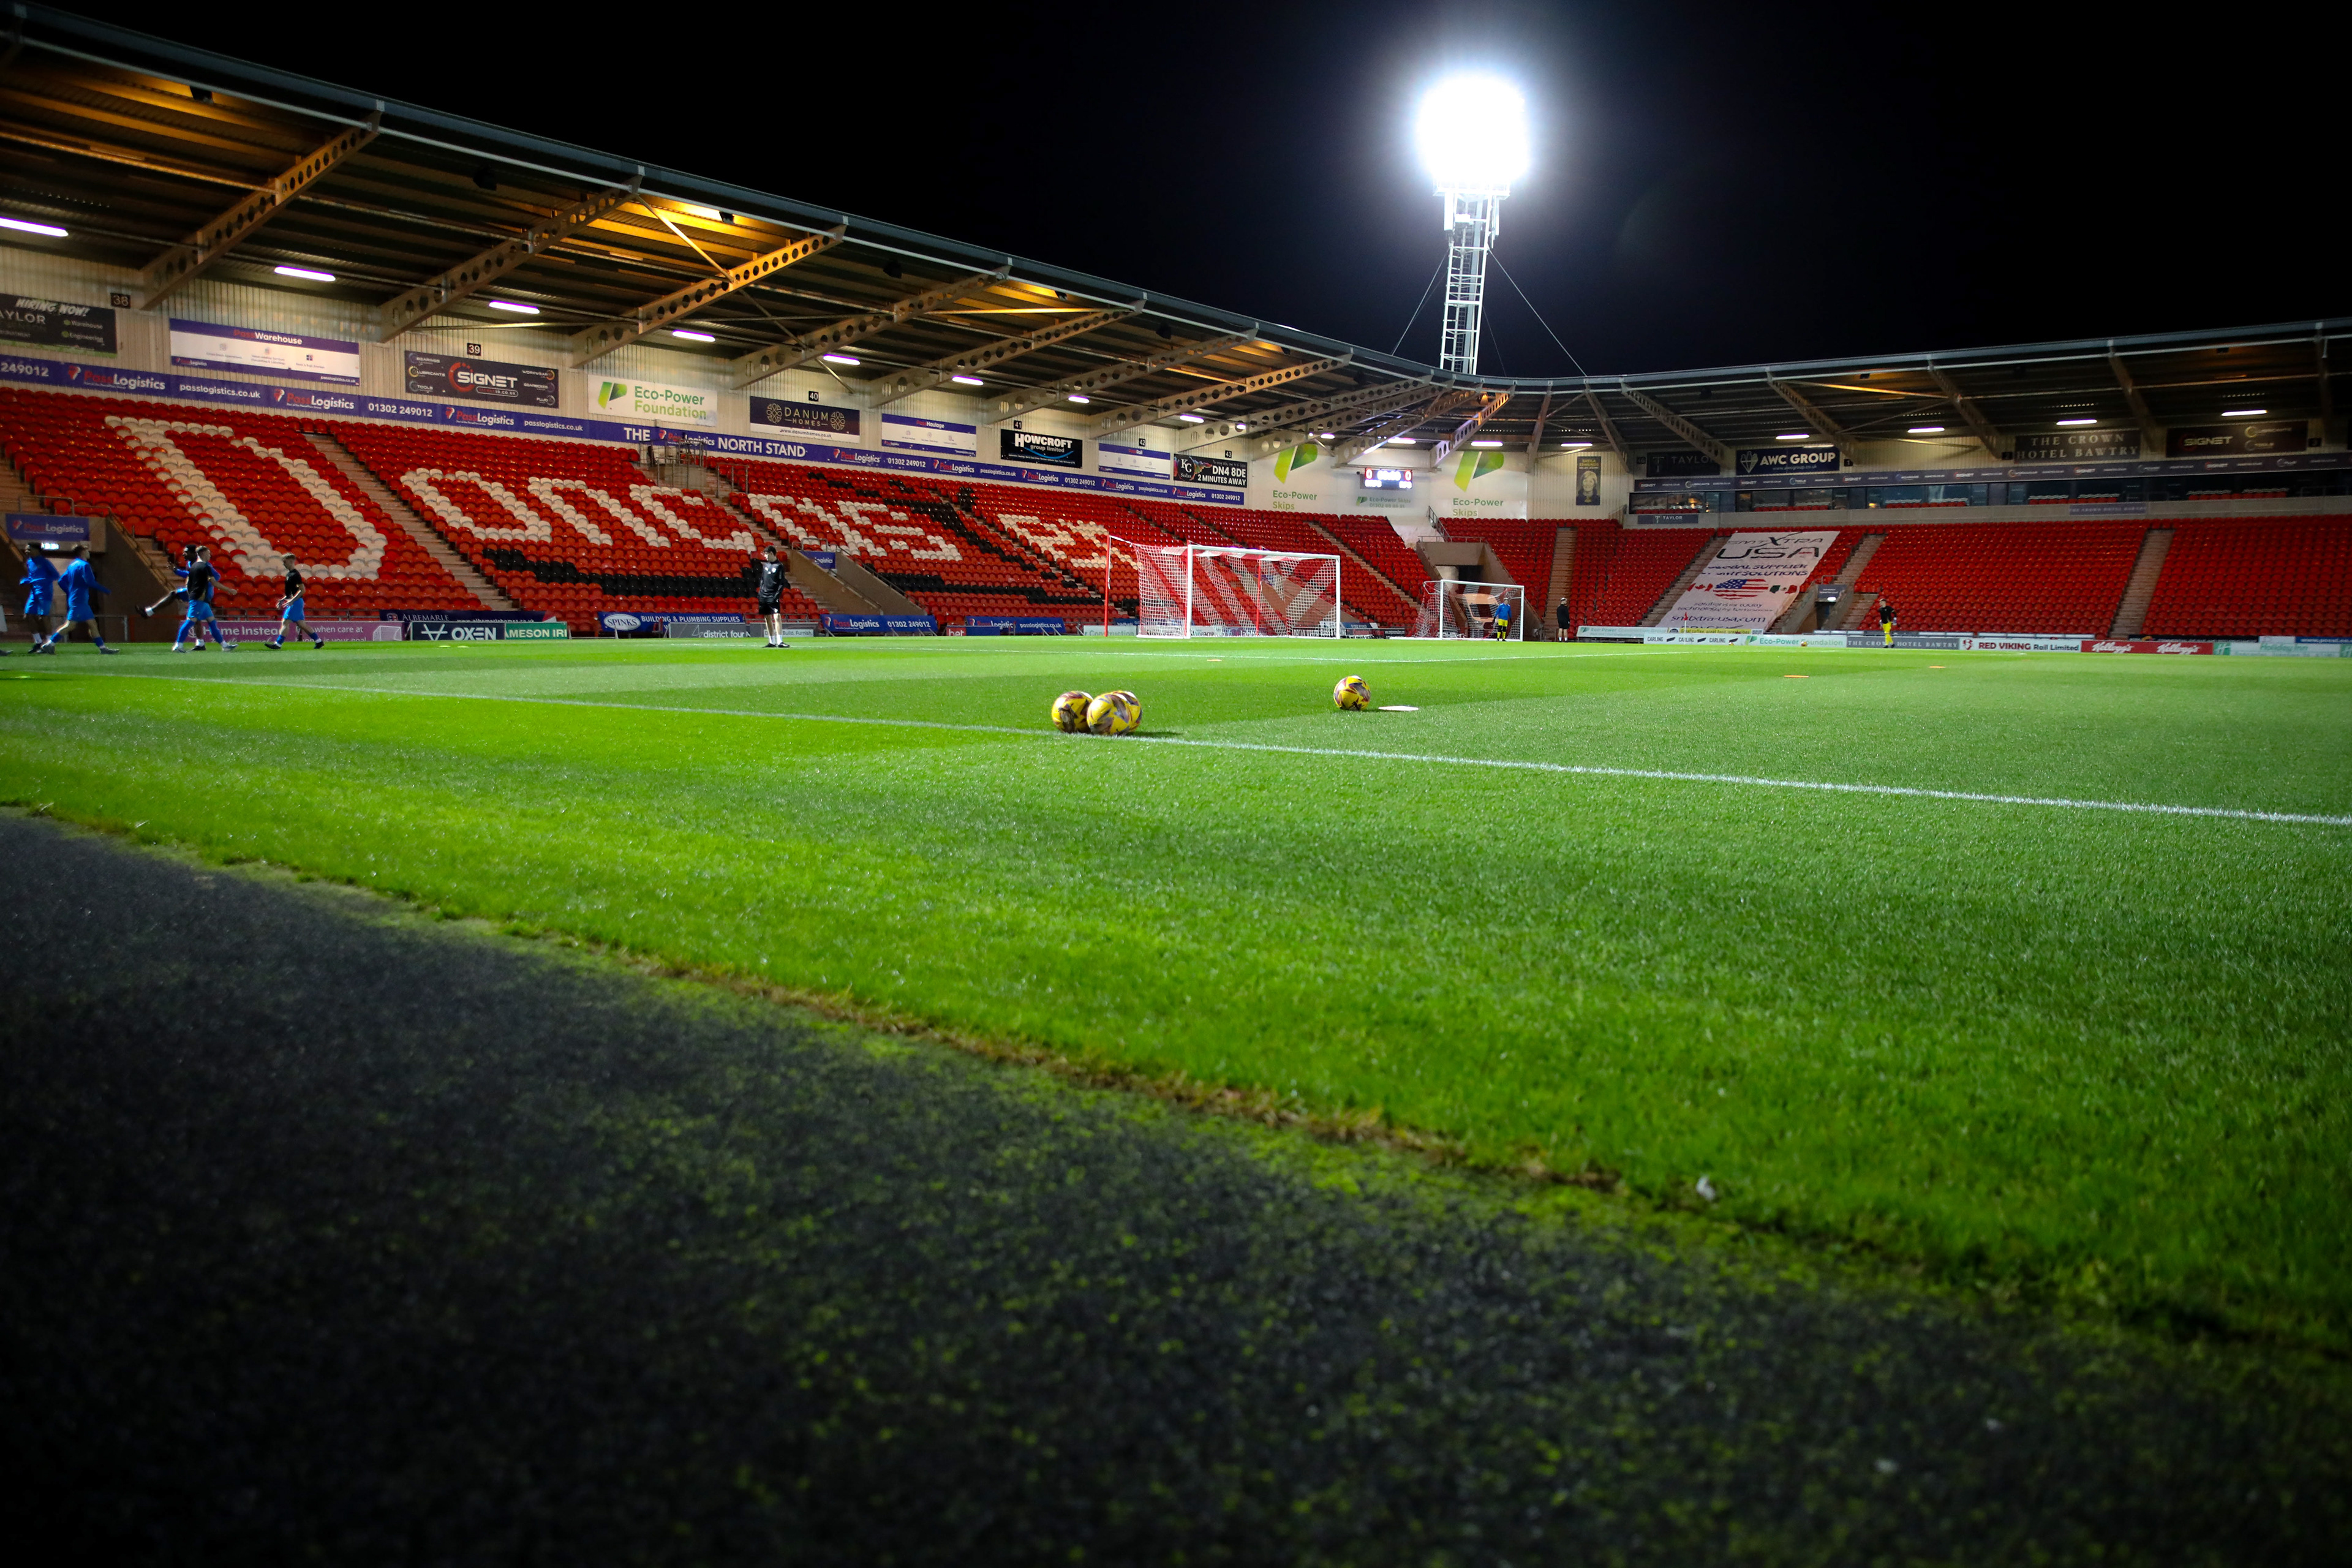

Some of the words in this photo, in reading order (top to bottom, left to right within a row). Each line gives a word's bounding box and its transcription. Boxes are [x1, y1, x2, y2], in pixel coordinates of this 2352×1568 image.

[113, 296, 129, 306] 38
[15, 298, 57, 312] HIRING
[59, 304, 91, 317] NOW!
[70, 320, 103, 330] Warehouse
[233, 329, 302, 345] PassWarehouse
[469, 344, 480, 354] 39
[1, 362, 49, 377] 249012
[84, 370, 166, 390] PassLogistics
[458, 370, 518, 388] SIGNET
[179, 383, 261, 399] passlogistics.co.uk
[635, 386, 705, 405] Eco-Power
[287, 393, 355, 410] PassLogistics
[369, 402, 397, 414] 01302
[399, 405, 433, 418] 249012
[635, 401, 707, 420] Foundation
[785, 407, 829, 421] DANUM
[456, 410, 514, 426] PassLogistics
[792, 418, 821, 427] HOMES
[524, 420, 583, 431] passlogistics.co.uk
[780, 429, 832, 439] www.danumhomes.co.uk
[624, 427, 650, 442] THE
[718, 437, 763, 453] NORTH
[766, 442, 806, 458] STAND
[1014, 432, 1073, 449] HOWCROFT
[2031, 435, 2061, 447] THE
[2068, 434, 2124, 445] CROWN
[2184, 435, 2233, 446] SIGNET
[841, 451, 880, 464] PassLogistics
[2016, 449, 2067, 459] HOTEL
[2075, 446, 2138, 458] BAWTRY
[888, 458, 905, 466] 01302
[906, 459, 926, 469] 249012
[1760, 454, 1787, 466] AWC
[1790, 452, 1836, 464] GROUP
[940, 462, 974, 473] PassLogistics
[1181, 459, 1192, 473] KC
[980, 468, 1017, 477] passlogistics.co.uk
[1028, 472, 1059, 483] PassLogistics
[1212, 466, 1230, 476] DN4
[1231, 467, 1246, 478] 8DE
[1202, 475, 1227, 484] MINUTES
[1106, 481, 1134, 491] PassLogistics
[1138, 486, 1168, 494] passlogistics.co.uk
[1177, 489, 1206, 499] PassLogistics
[1273, 490, 1317, 500] Eco-Power
[1273, 502, 1295, 510] Skips
[1453, 498, 1504, 507] Eco-Power
[1453, 509, 1478, 518] Skips
[1716, 547, 1819, 559] USA
[608, 618, 637, 627] SPINKS
[834, 619, 880, 629] PassLogistics
[977, 620, 1016, 630] PassLogistic
[203, 626, 239, 635] Hme
[242, 626, 282, 635] Instea
[451, 627, 497, 640] OXEN
[704, 630, 729, 638] district
[731, 630, 744, 638] four
[2092, 641, 2135, 654] Kellogg's
[2157, 643, 2202, 655] Kellogg's
[2260, 643, 2294, 652] Holiday
